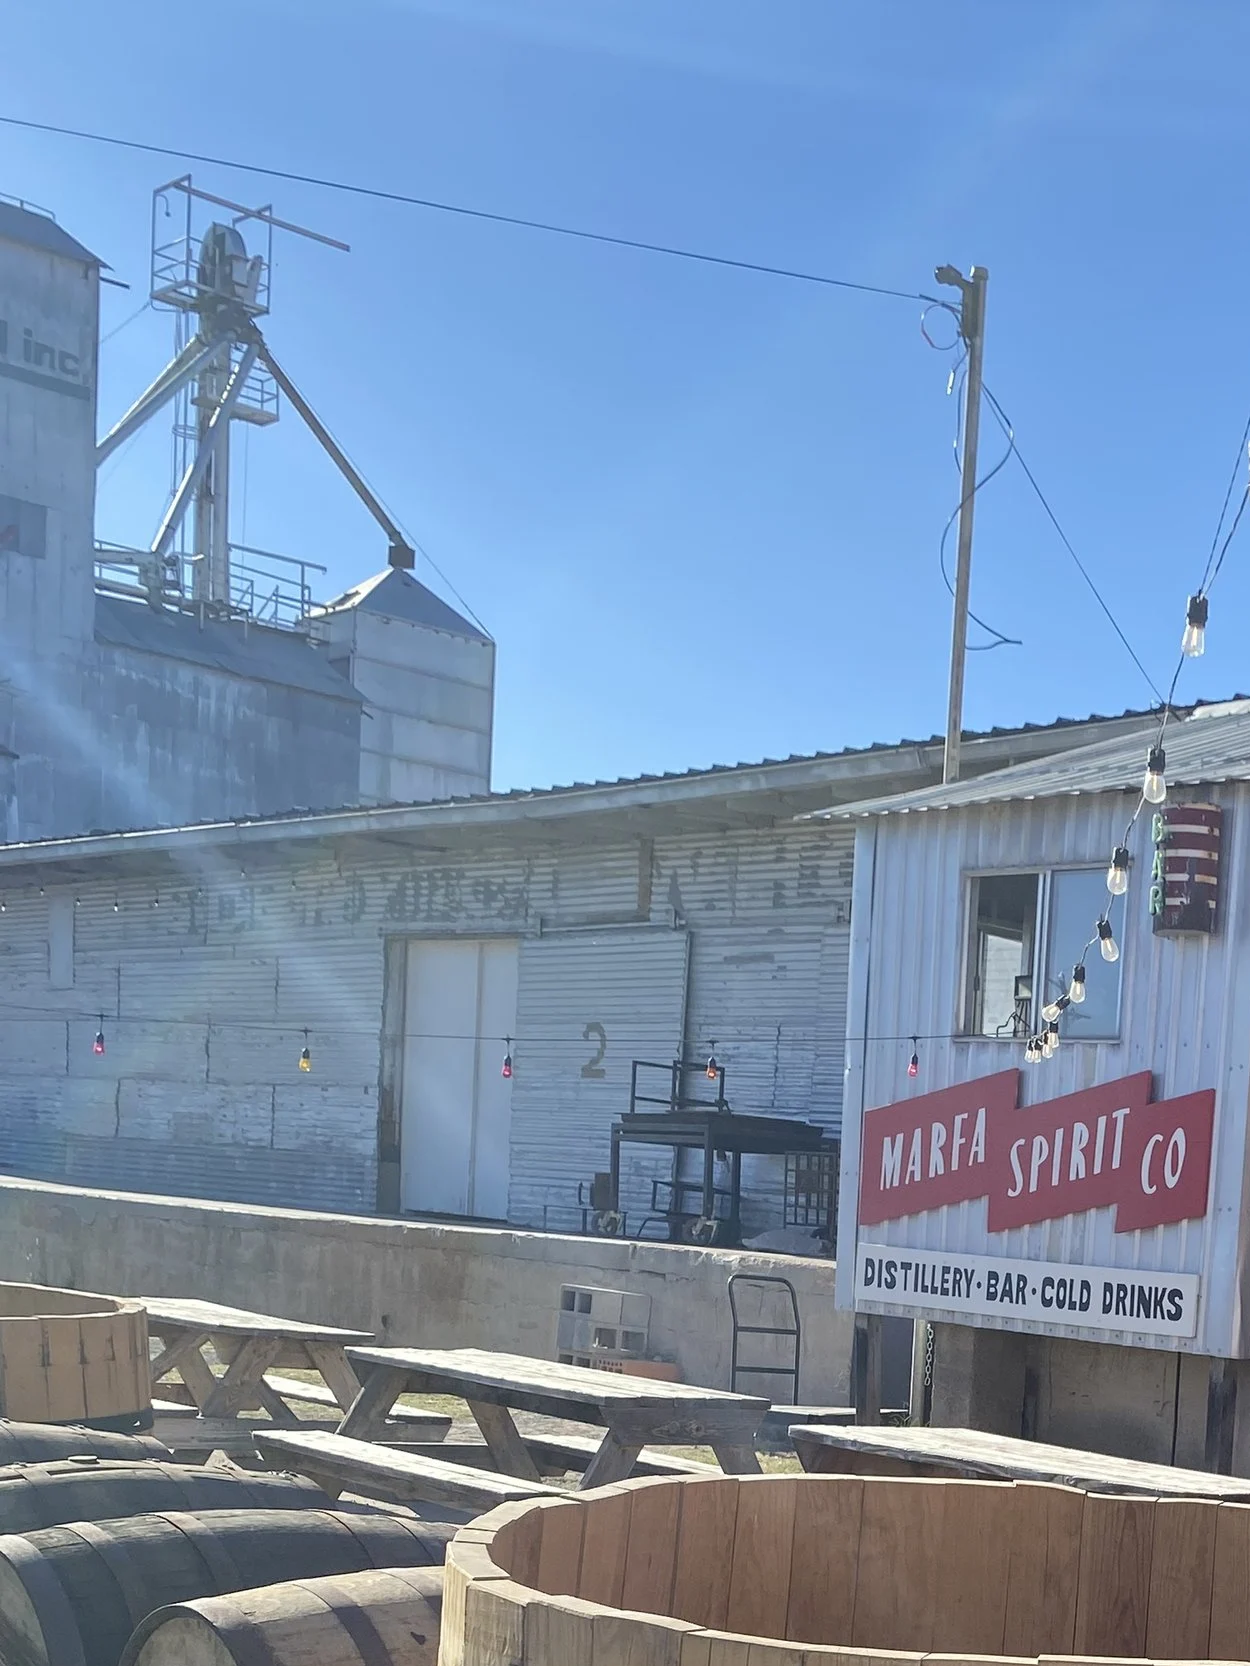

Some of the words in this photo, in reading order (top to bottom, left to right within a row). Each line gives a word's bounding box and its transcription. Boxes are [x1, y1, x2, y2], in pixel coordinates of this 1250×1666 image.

[1148, 812, 1164, 916] BAR
[581, 1021, 607, 1078] 2
[880, 1107, 986, 1191] MARFA
[1007, 1107, 1130, 1198] SPIRIT
[1141, 1127, 1186, 1195] CO
[863, 1257, 976, 1299] DISTILLERY
[986, 1270, 1028, 1306] BAR
[1040, 1276, 1091, 1312] COLD
[1101, 1282, 1184, 1322] DRINKS
